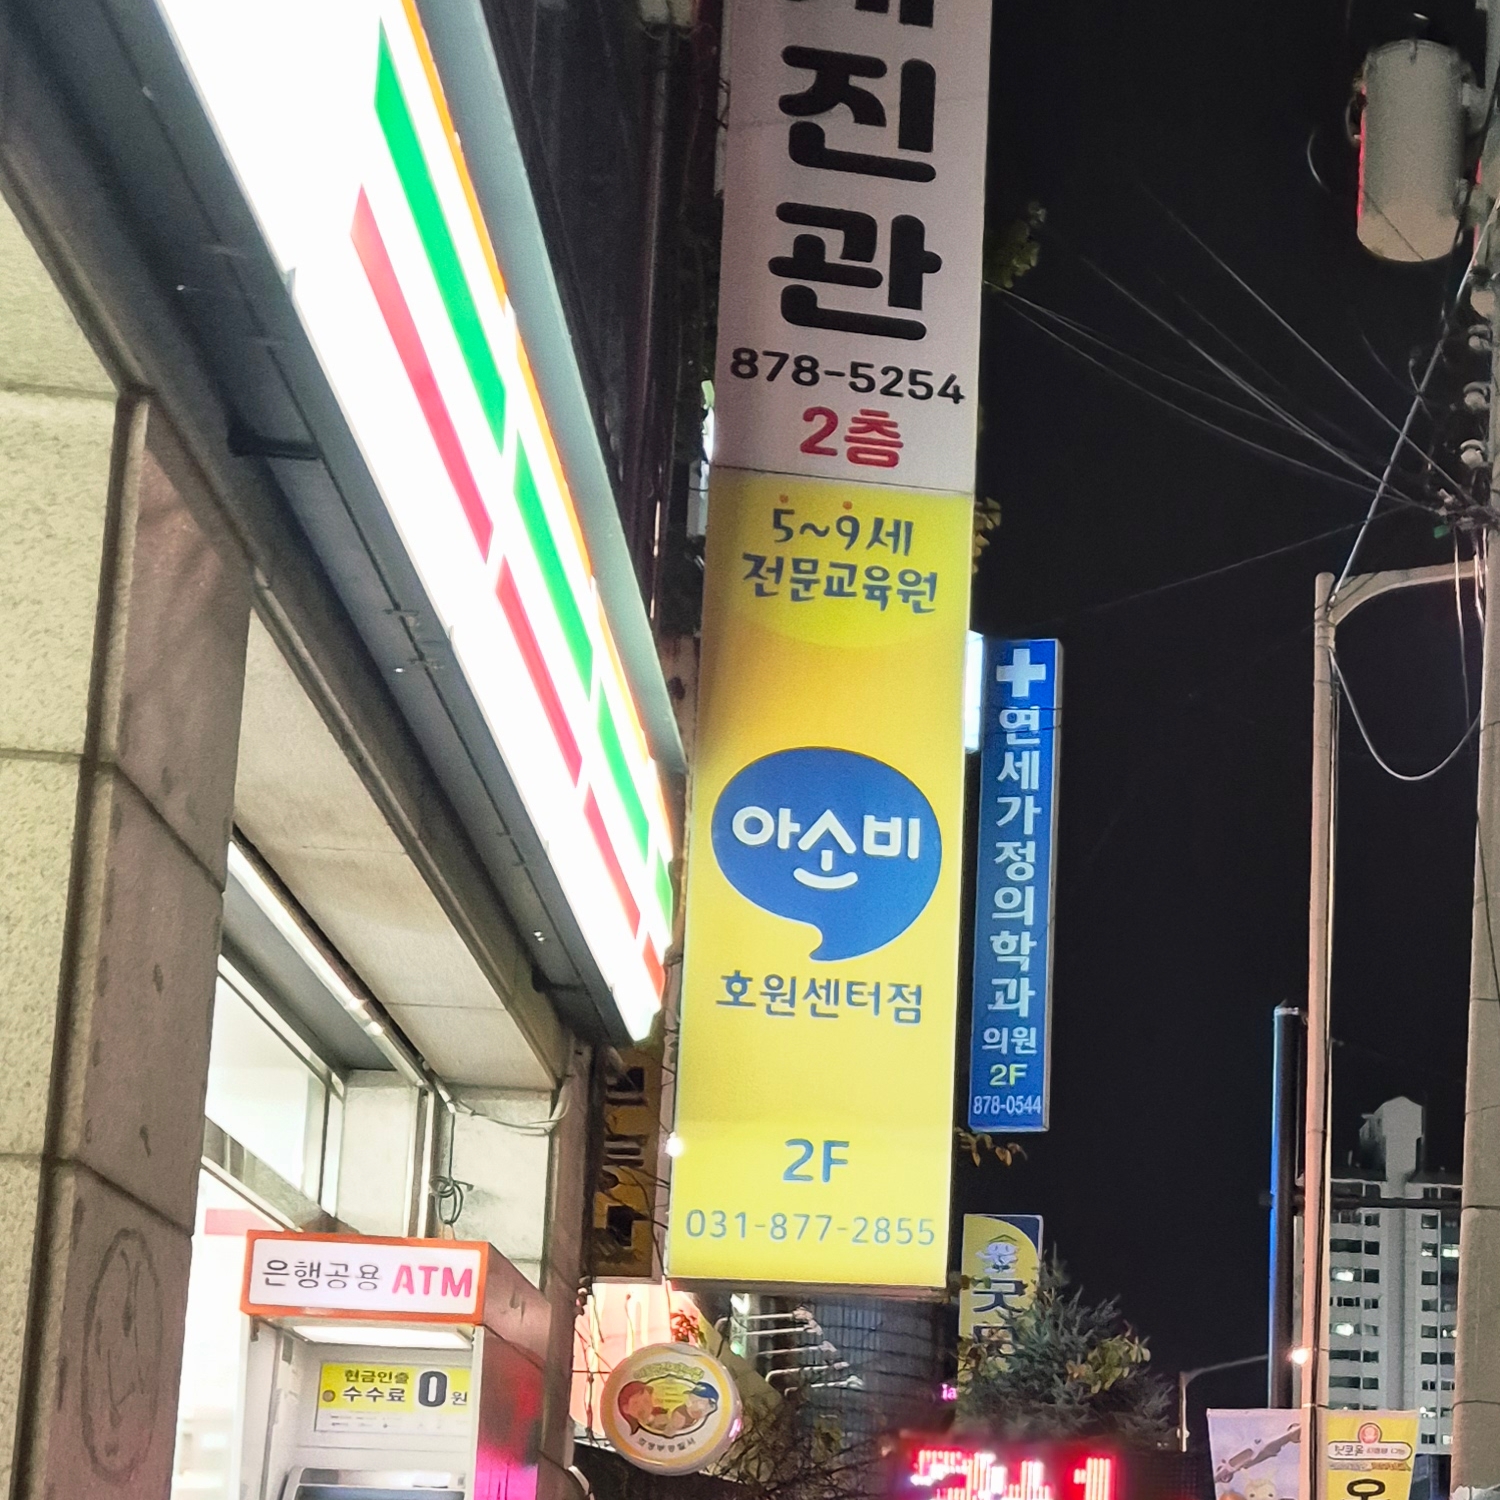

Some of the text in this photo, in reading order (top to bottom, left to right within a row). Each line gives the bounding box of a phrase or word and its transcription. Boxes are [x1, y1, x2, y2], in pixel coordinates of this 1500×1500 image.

[768, 0, 943, 341] 진관
[729, 347, 965, 404] 878-5254
[799, 406, 905, 468] 2층
[771, 507, 915, 556] 5~9세
[741, 552, 939, 614] 전문교육원
[731, 805, 921, 889] 아소비
[987, 706, 1041, 1018] 연세가정의학과
[715, 970, 923, 1025] 호원센터점
[982, 1026, 1038, 1055] 의원
[988, 1064, 1028, 1086] 2F
[973, 1095, 1042, 1115] 878-0544
[782, 1138, 850, 1183] 2F
[685, 1209, 936, 1246] 031-877-2855
[262, 1259, 474, 1299] 은행공용 ATM
[342, 1386, 406, 1402] 수수료
[344, 1369, 409, 1384] 현금인출
